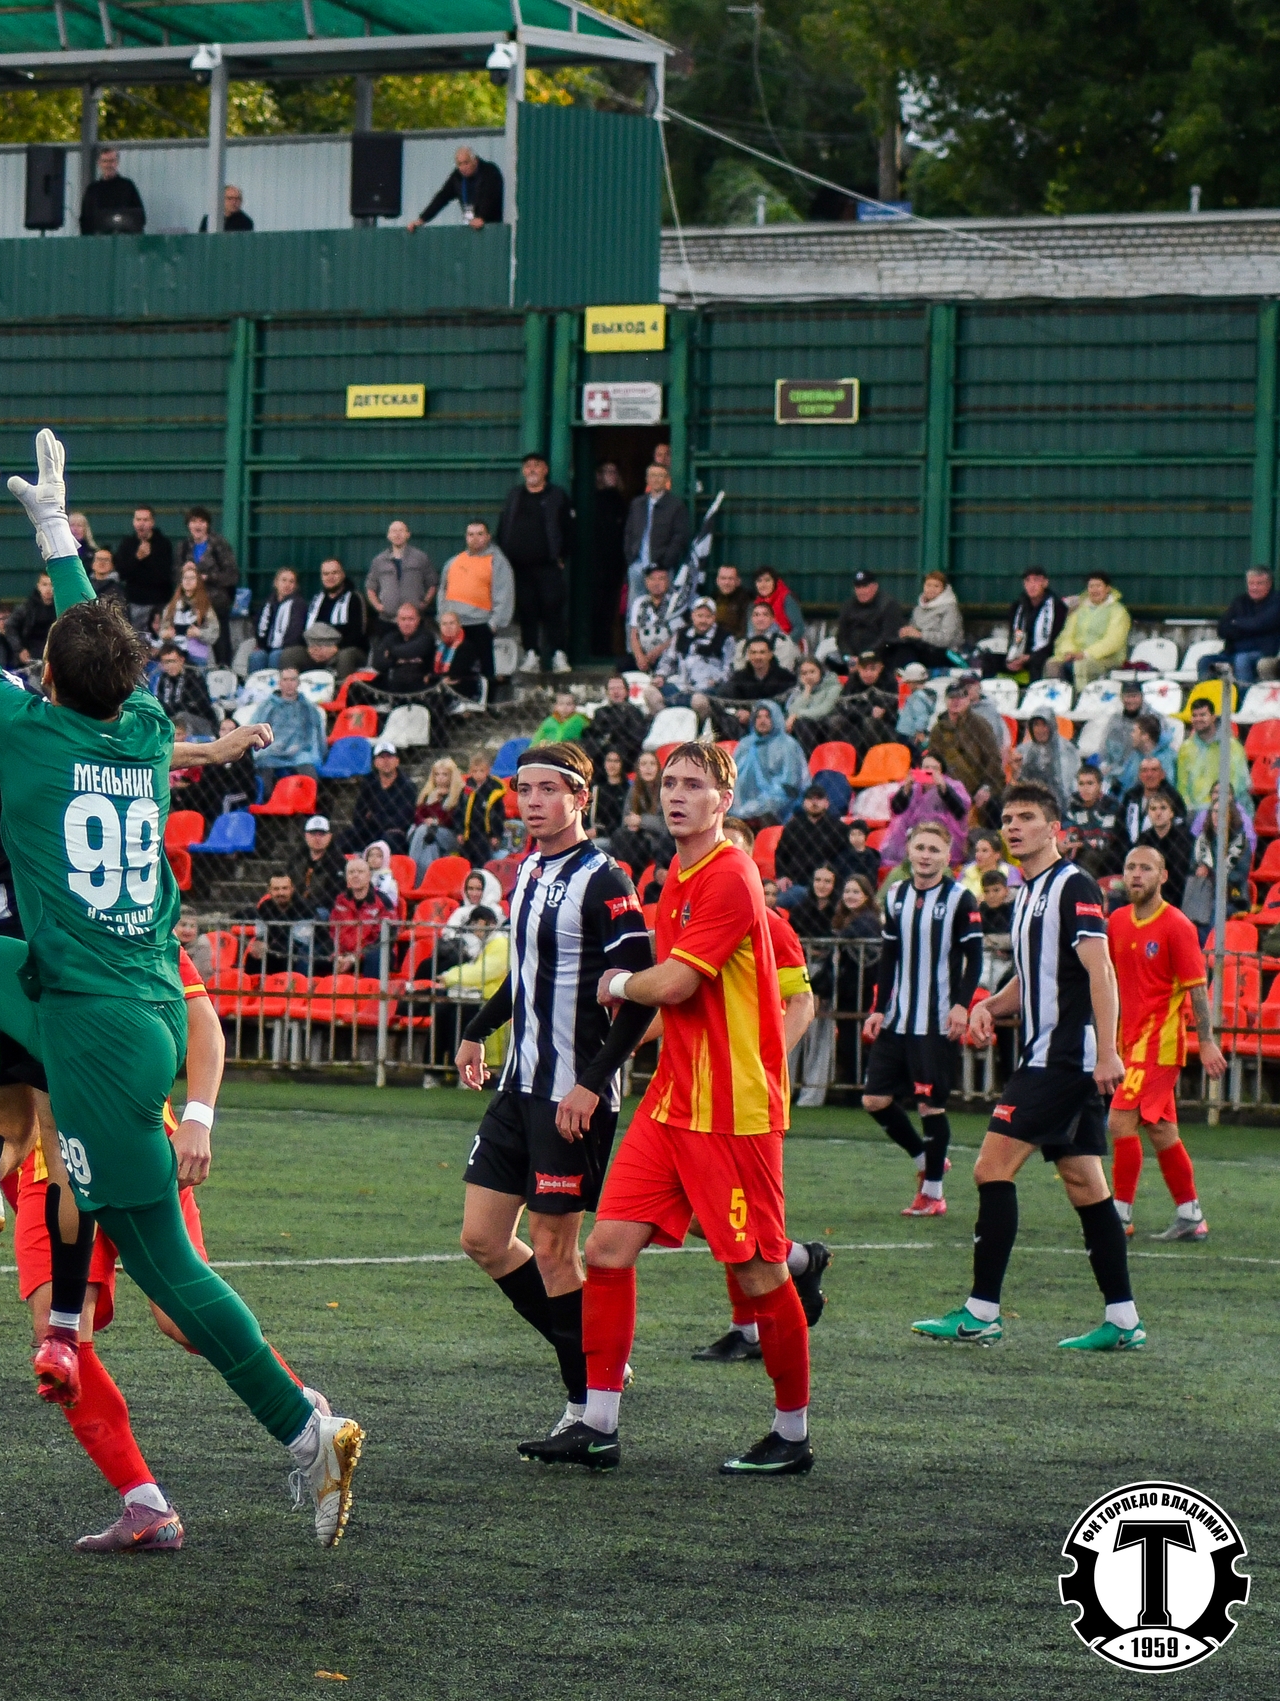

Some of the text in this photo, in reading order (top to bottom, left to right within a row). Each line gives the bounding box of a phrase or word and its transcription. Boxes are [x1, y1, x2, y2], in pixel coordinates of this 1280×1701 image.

[591, 320, 659, 335] ВЫХОД 4
[353, 393, 420, 407] ДЕТСКАЯ
[73, 762, 155, 798] МЕЛЬНИК
[64, 793, 160, 910] 99
[729, 1188, 747, 1230] 5
